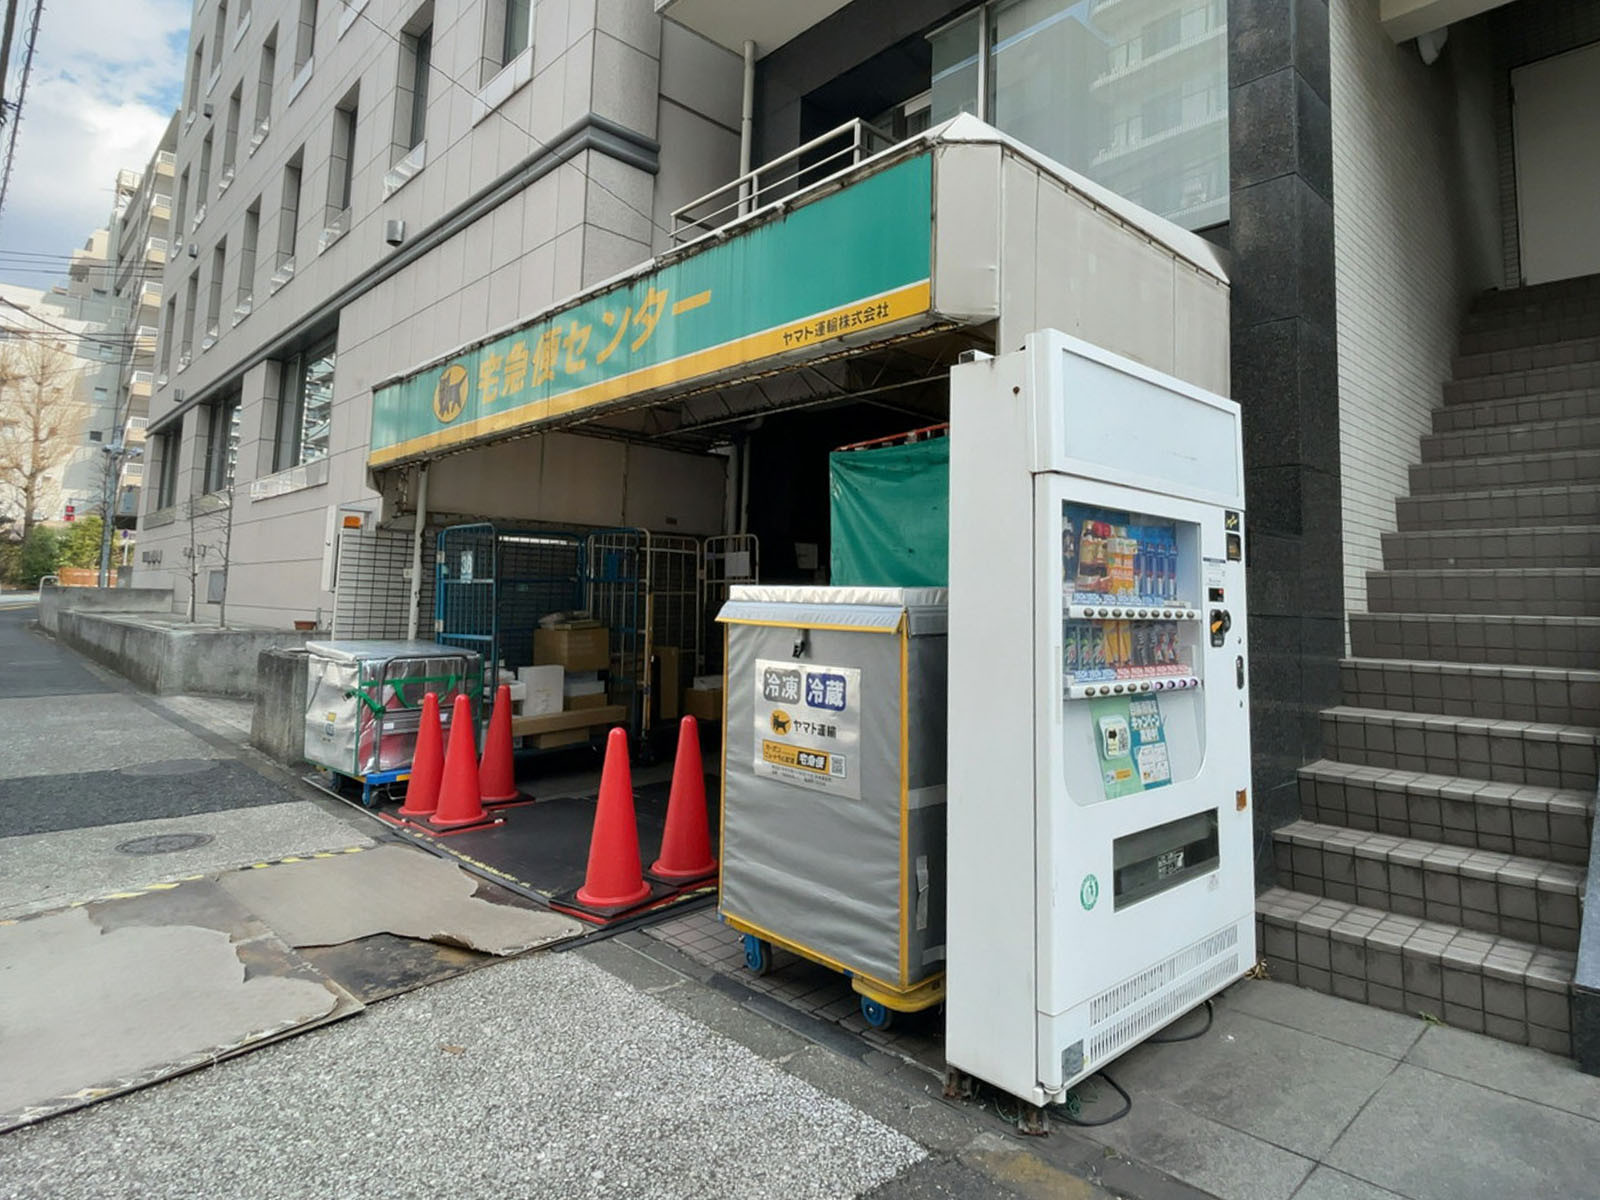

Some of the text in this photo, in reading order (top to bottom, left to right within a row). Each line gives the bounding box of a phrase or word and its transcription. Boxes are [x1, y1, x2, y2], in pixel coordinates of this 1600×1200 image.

[783, 301, 889, 346] ヤマト運輸株式会社
[478, 287, 711, 404] 宅急便センター
[765, 673, 844, 707] 冷凍 冷蔵
[793, 720, 837, 738] ヤマト運輸
